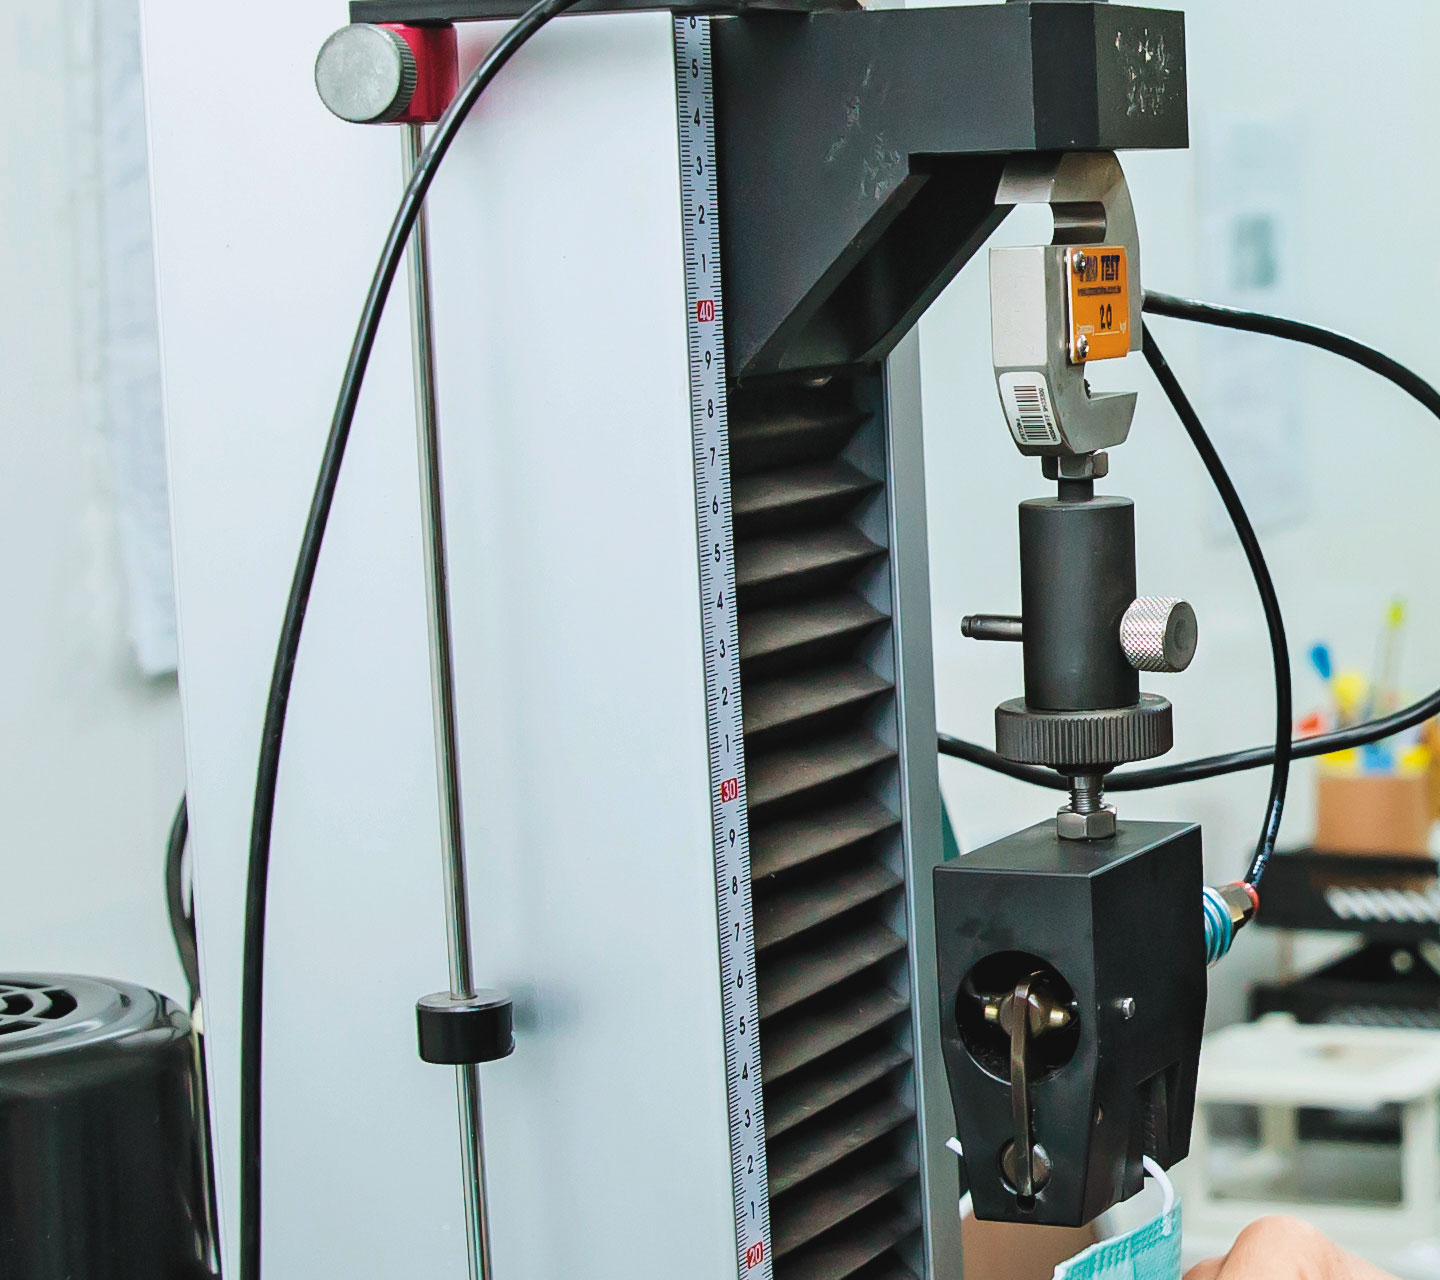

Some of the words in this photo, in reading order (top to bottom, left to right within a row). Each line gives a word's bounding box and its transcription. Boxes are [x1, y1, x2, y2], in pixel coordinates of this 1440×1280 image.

[1101, 255, 1120, 281] TEST
[699, 301, 712, 320] 40
[722, 780, 736, 801] 30
[748, 1244, 762, 1268] 20
